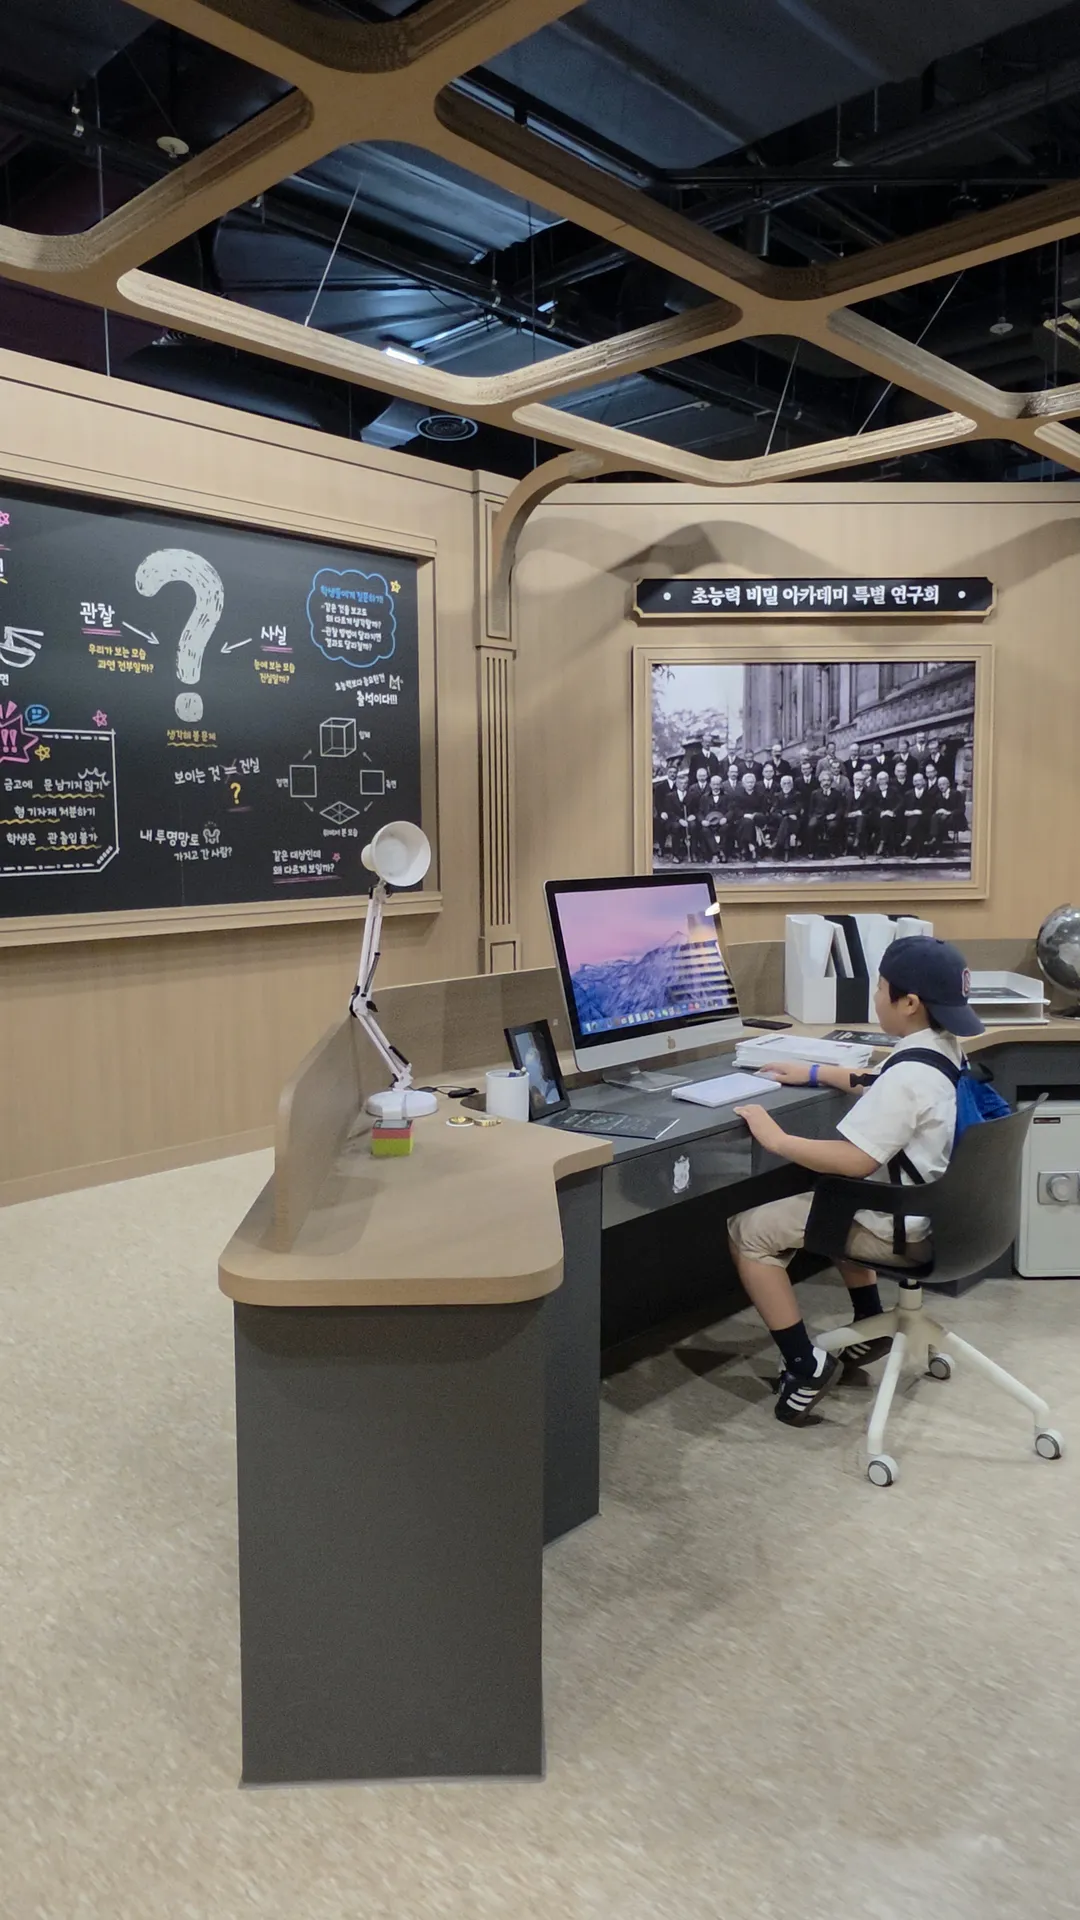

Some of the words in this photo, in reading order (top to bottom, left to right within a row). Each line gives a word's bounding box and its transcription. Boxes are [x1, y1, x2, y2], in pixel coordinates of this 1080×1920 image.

[691, 585, 740, 606] 초능력
[746, 585, 778, 606] 비밀
[782, 585, 848, 606] 아카데미
[852, 585, 885, 606] 특별
[890, 585, 939, 605] 연구회
[80, 602, 115, 628] 관찰
[261, 625, 287, 646] 사실
[88, 643, 113, 655] 우리가
[114, 646, 130, 659] 보는
[131, 648, 146, 661] 모습
[97, 659, 116, 671] 과연
[117, 660, 154, 674] 전부일까?
[167, 729, 191, 740] 생각해
[201, 730, 216, 742] 문제
[174, 768, 206, 785] 보이는
[208, 765, 221, 782] 것
[239, 757, 260, 774] 진실
[4, 778, 33, 791] 금고에
[55, 779, 82, 791] 남기지
[84, 780, 103, 793] 않기
[27, 806, 57, 817] 기자재
[59, 805, 96, 818] 처분하기
[6, 832, 37, 845] 학생은
[60, 831, 77, 845] 출입
[79, 832, 98, 845] 불가
[140, 829, 152, 842] 내
[174, 850, 199, 861] 가지고
[201, 848, 209, 860] 간
[211, 846, 232, 859] 사람?
[272, 849, 289, 862] 같은
[290, 849, 321, 861] 대상인데
[272, 865, 282, 875] 왜
[284, 864, 307, 874] 다르게
[308, 863, 335, 875] 보일까?
